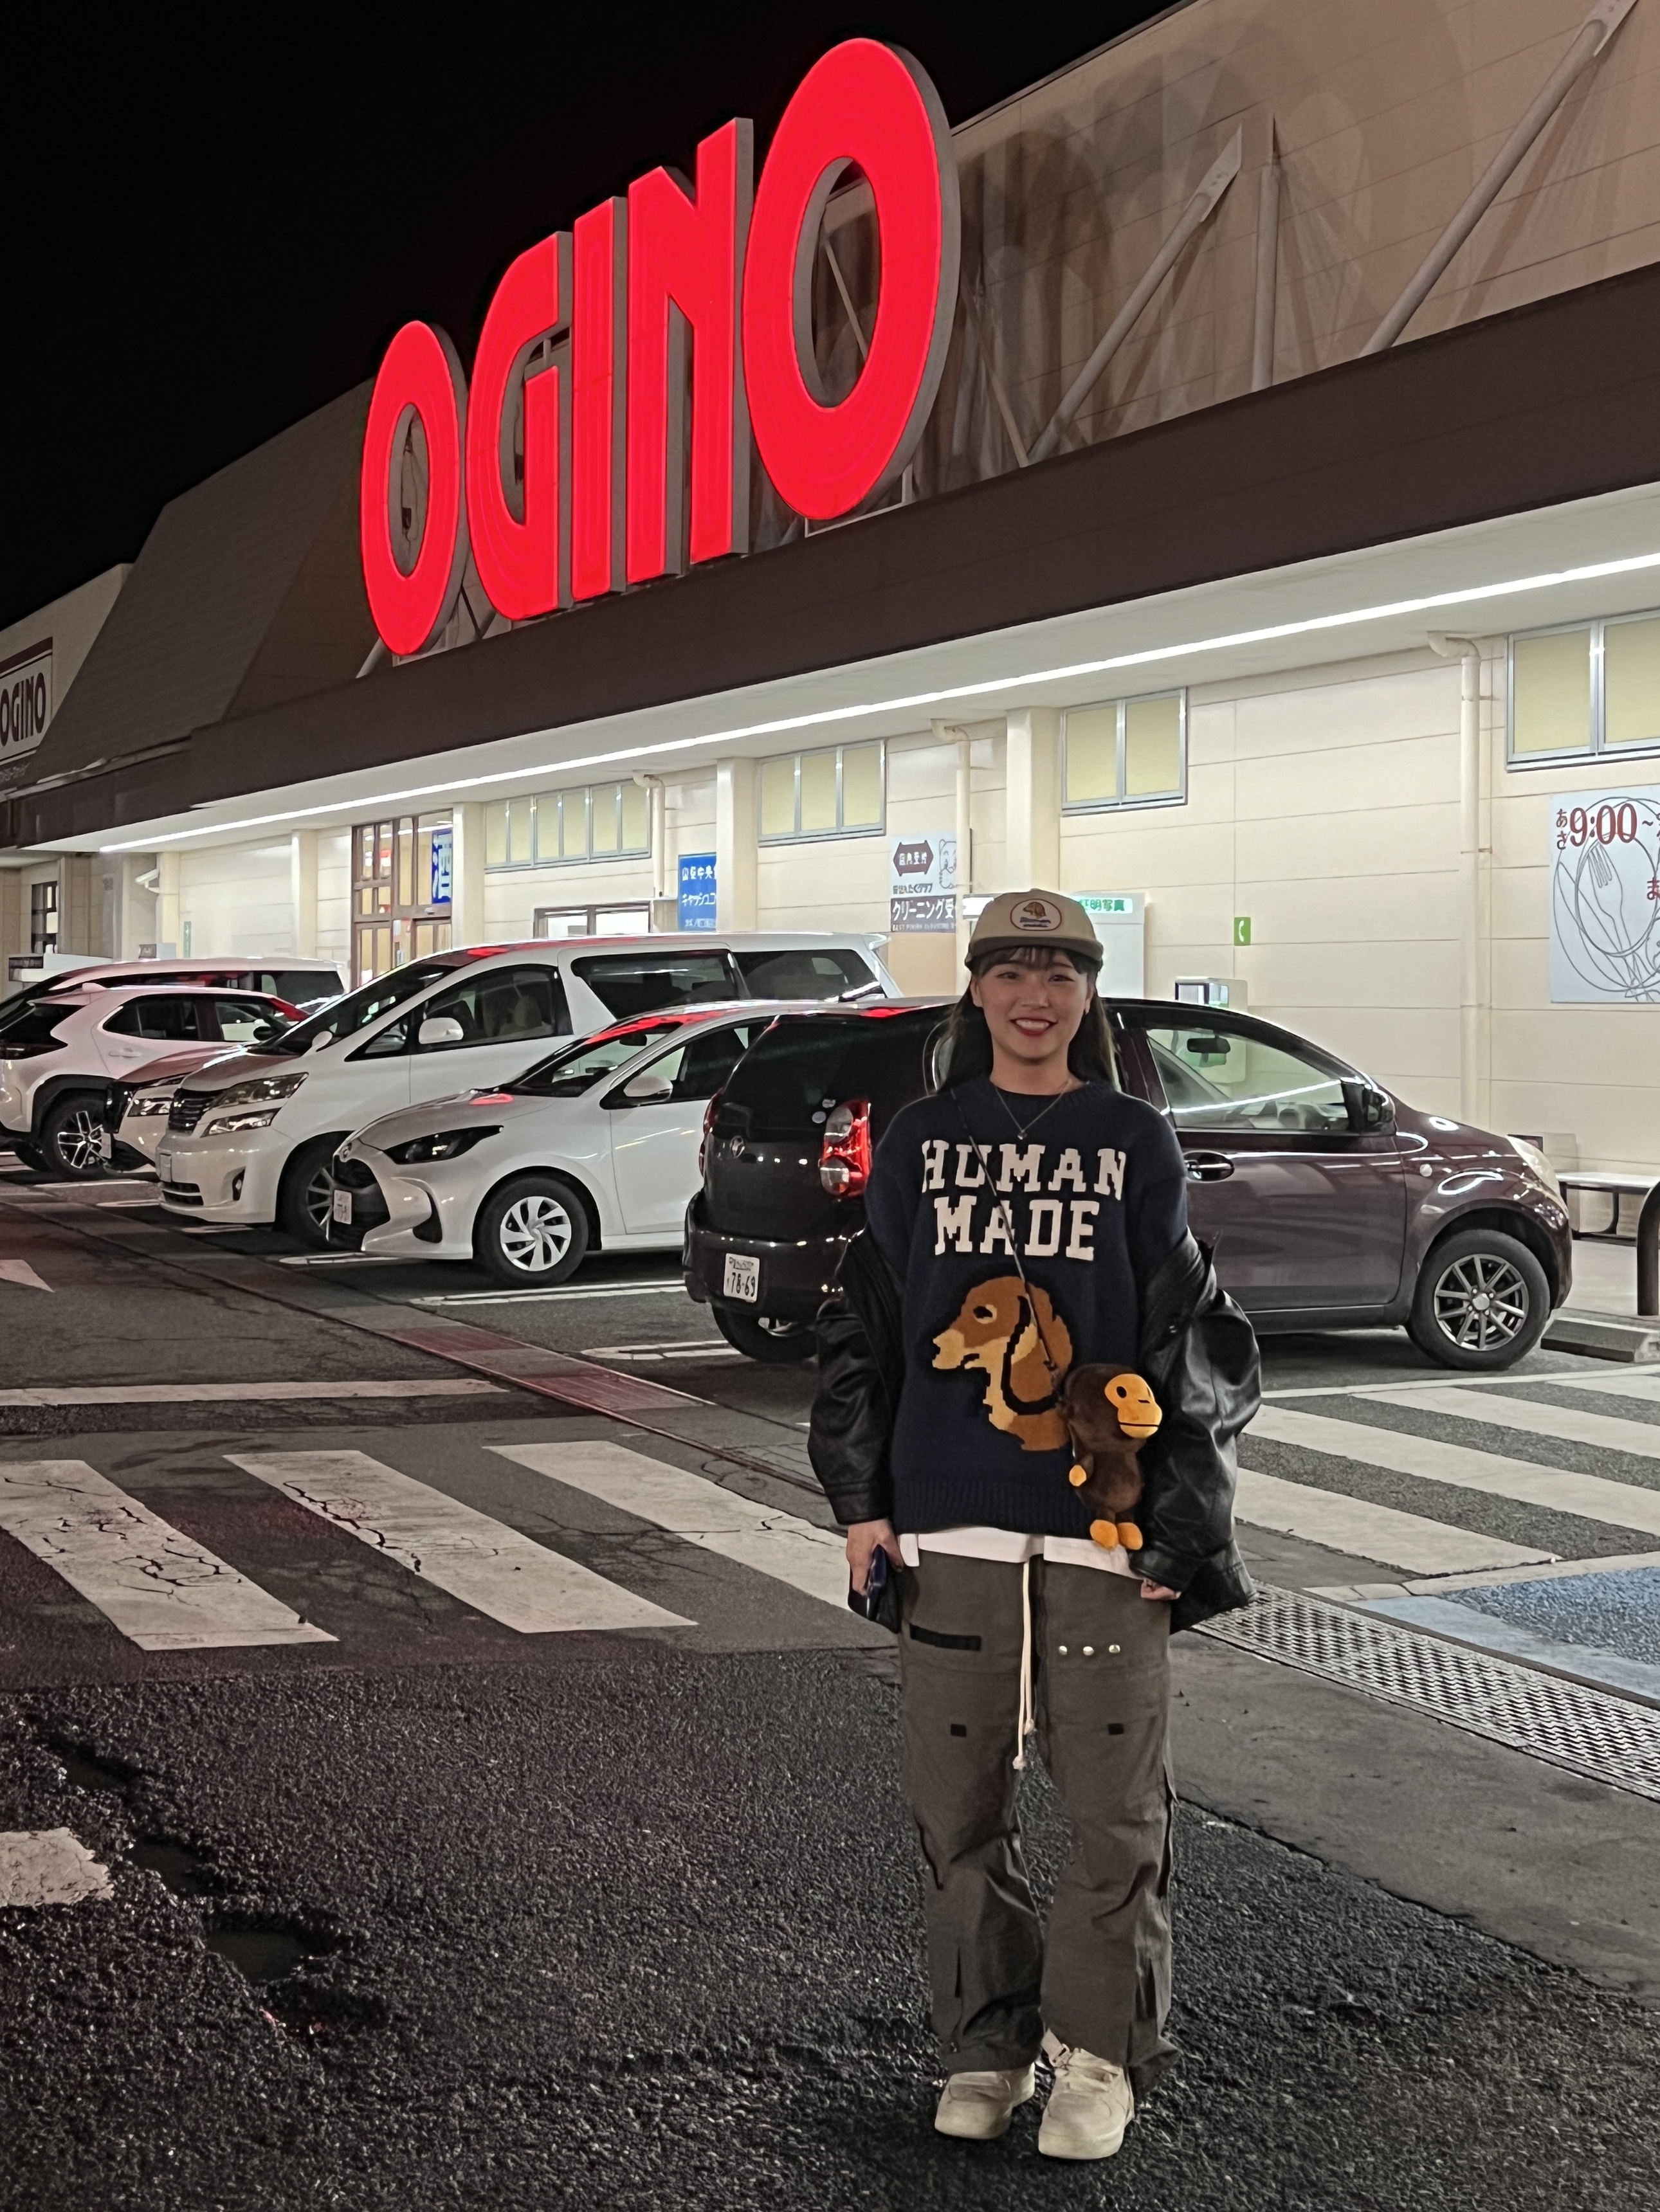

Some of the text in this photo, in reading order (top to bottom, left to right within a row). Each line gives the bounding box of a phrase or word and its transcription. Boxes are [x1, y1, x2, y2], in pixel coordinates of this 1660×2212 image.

[361, 38, 942, 655] OGINO
[1, 673, 46, 747] OGINO
[922, 1139, 1126, 1200] HUMAN
[934, 1195, 1099, 1260] MADE
